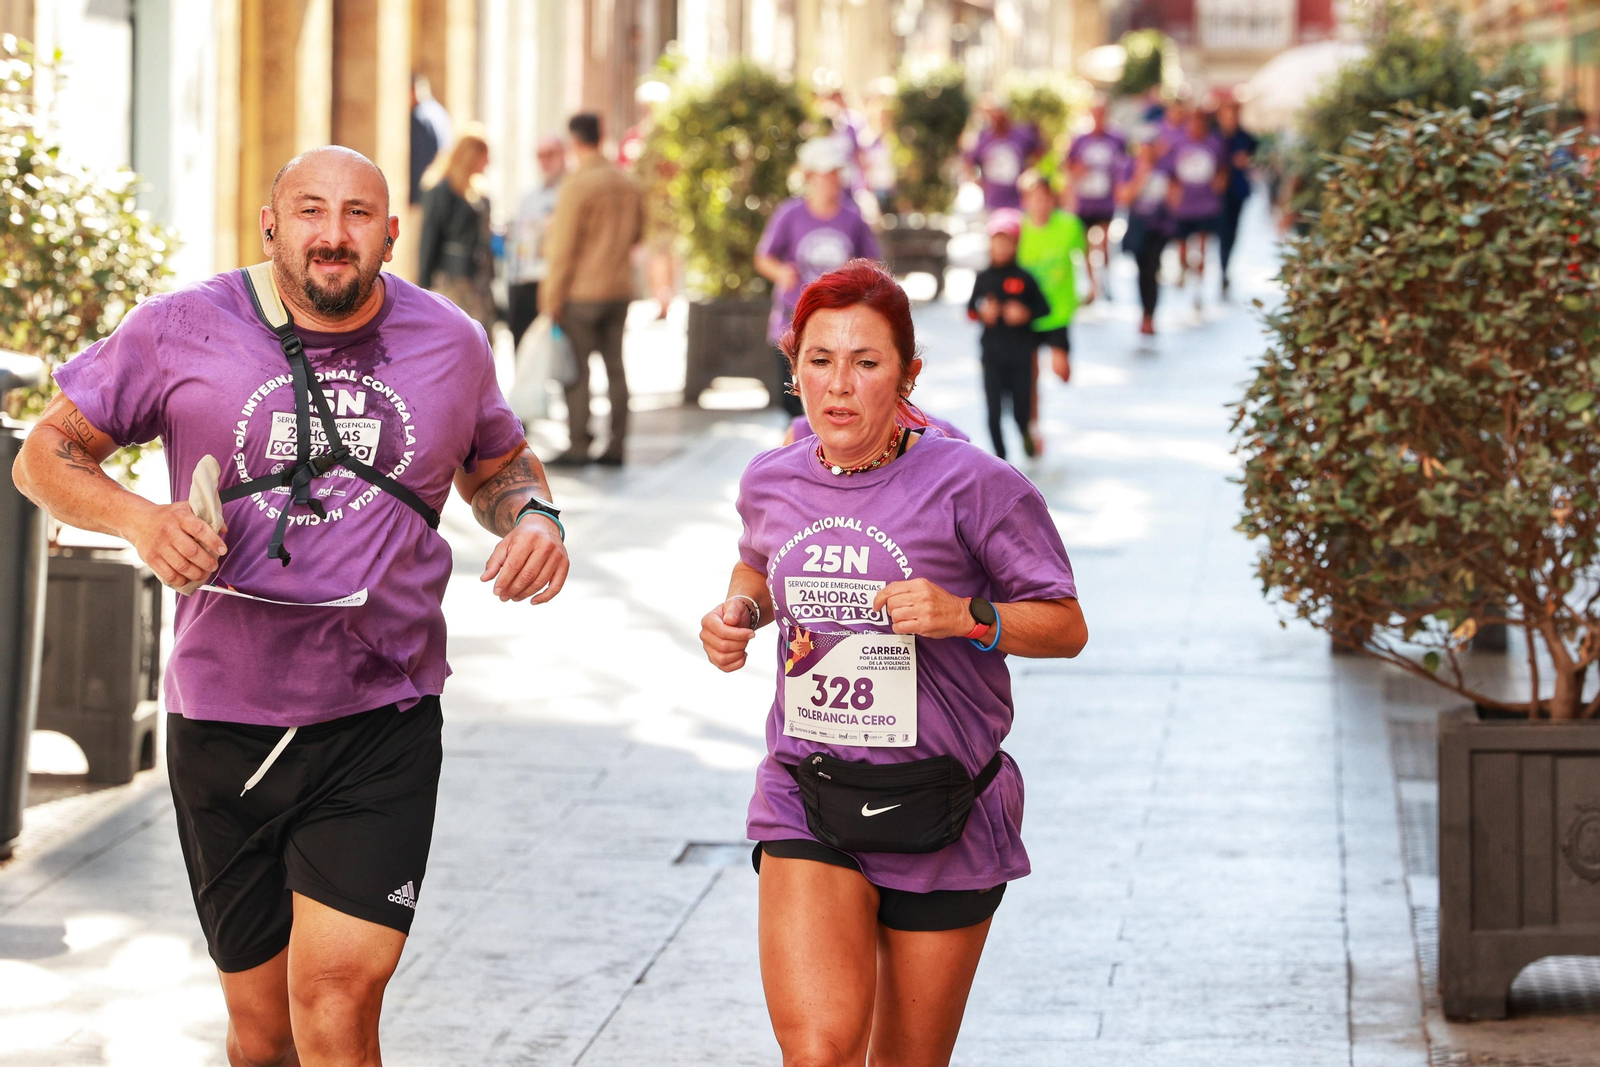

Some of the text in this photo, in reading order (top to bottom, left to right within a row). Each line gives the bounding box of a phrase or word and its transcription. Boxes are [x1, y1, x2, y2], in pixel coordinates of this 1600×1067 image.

[362, 375, 411, 423] CONTRA
[233, 420, 248, 448] DÍA
[404, 425, 416, 446] LA
[348, 451, 415, 511] VIOLNCIA
[769, 516, 862, 580] INTERNACIONAL
[866, 525, 913, 579] CONTRA
[802, 544, 870, 574] 25N
[830, 582, 881, 591] EMERGENCIAS
[792, 605, 824, 619] 900
[841, 606, 854, 620] 21
[860, 606, 881, 621] 30
[862, 646, 910, 655] CARRERA
[810, 674, 874, 710] 328
[797, 706, 896, 726] TOLERANCIA CERO
